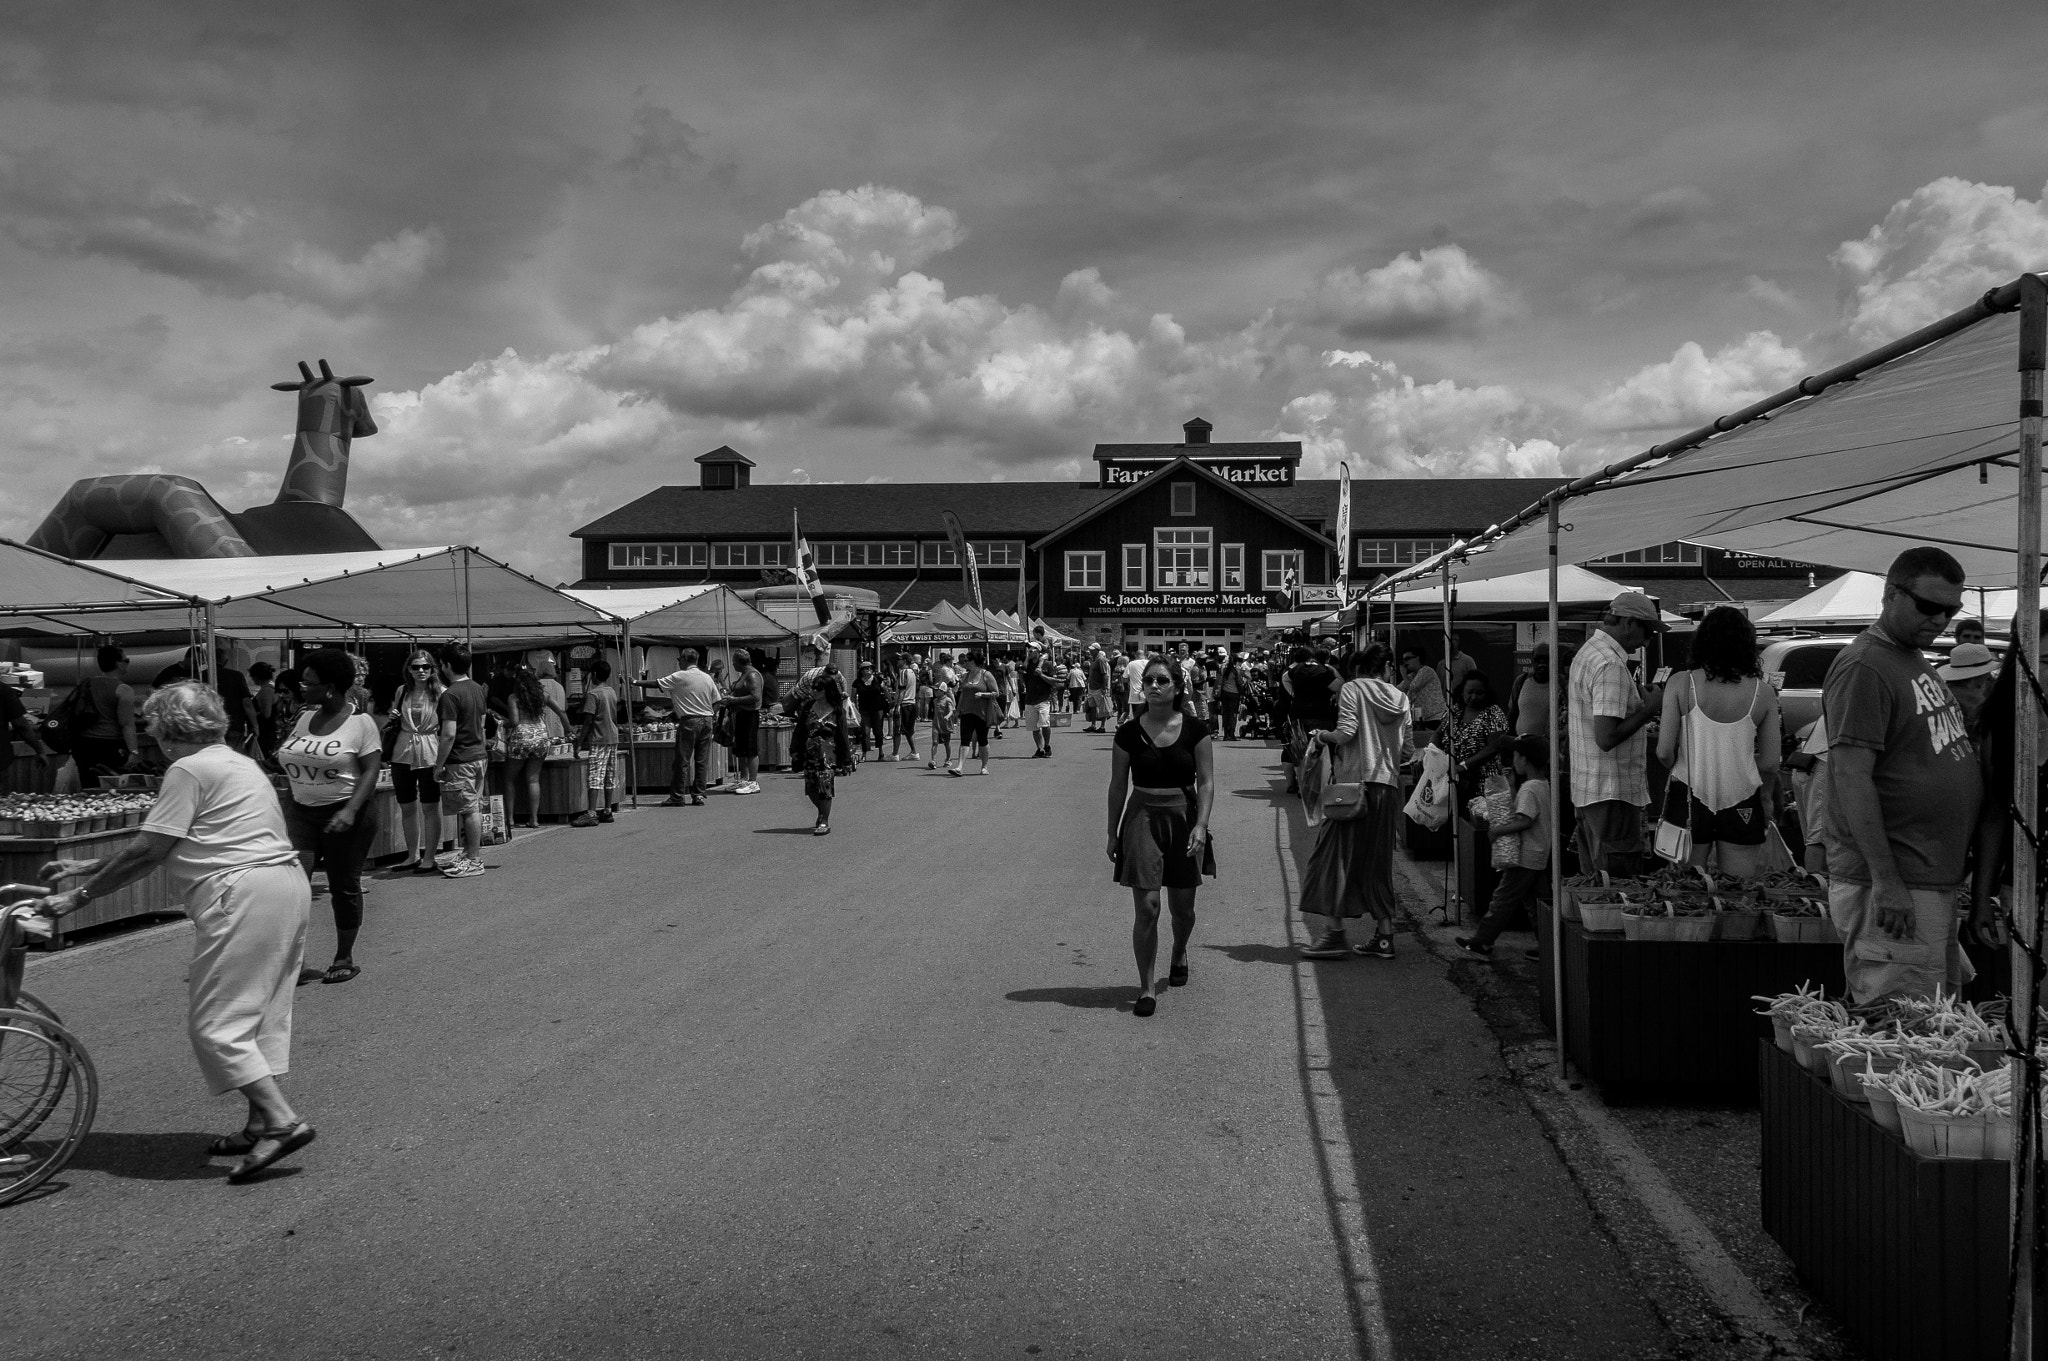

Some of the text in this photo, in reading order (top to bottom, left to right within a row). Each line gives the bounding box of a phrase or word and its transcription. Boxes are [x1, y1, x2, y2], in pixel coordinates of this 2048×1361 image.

[1210, 463, 1289, 482] Market
[1737, 560, 1765, 568] OPEN
[1767, 560, 1787, 568] ALL
[1099, 594, 1115, 605] St.
[1116, 593, 1159, 607] Jacobs
[1221, 593, 1267, 605] Market
[1186, 606, 1204, 615] Open
[1218, 606, 1235, 614] June
[1267, 606, 1280, 615] Day
